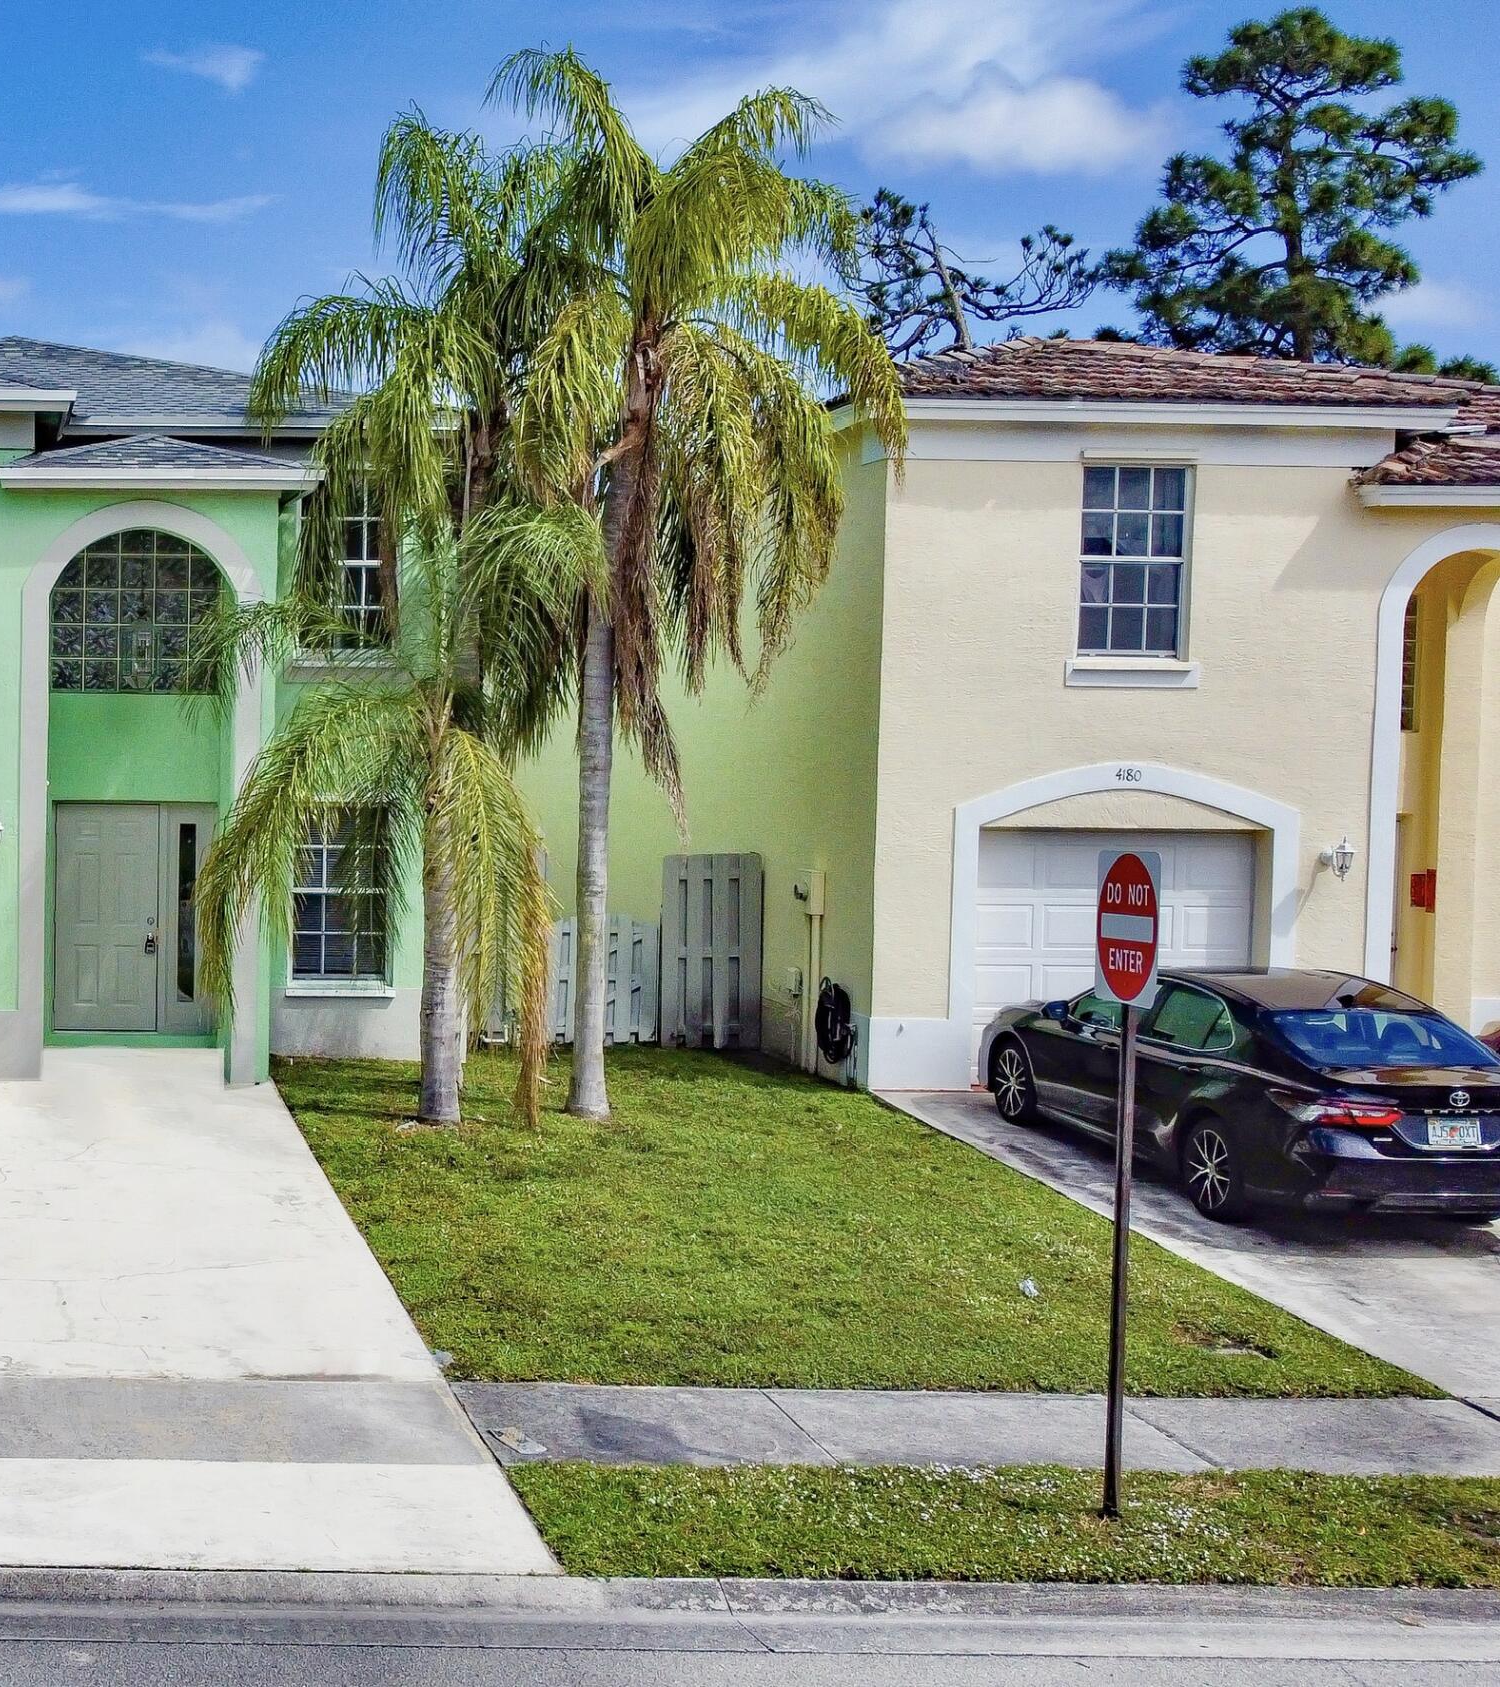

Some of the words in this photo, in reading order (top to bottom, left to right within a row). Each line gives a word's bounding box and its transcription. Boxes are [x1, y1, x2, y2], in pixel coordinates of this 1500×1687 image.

[1115, 768, 1142, 782] 4180
[1107, 882, 1122, 904] DO
[1128, 883, 1150, 906] NOT
[1108, 948, 1143, 974] ENTER
